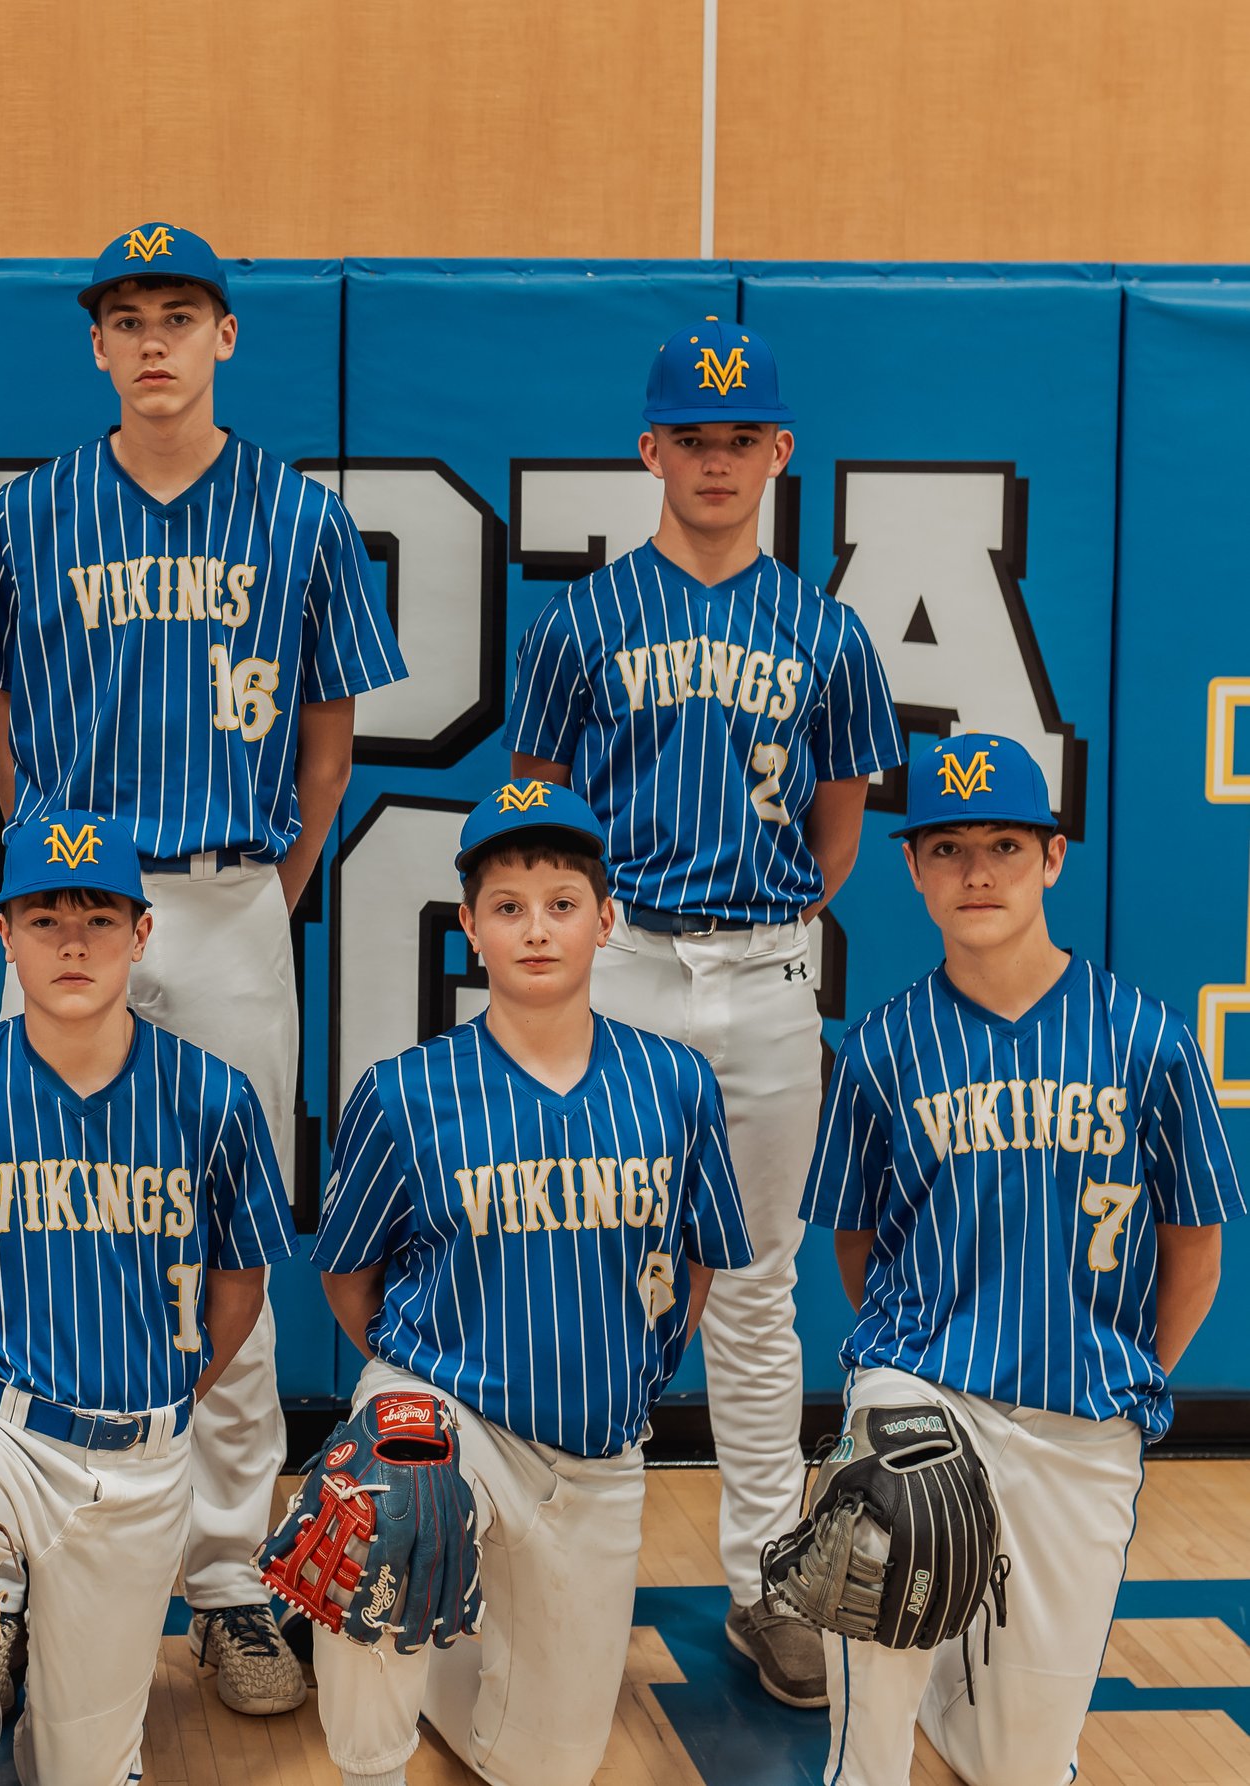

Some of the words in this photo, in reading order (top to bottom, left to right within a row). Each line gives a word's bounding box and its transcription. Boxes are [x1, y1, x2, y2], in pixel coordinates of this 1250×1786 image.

[67, 555, 257, 630] VIKINGS
[209, 644, 283, 742] 16
[614, 634, 803, 721] VIKINGS
[750, 741, 791, 827] 2
[912, 1077, 1127, 1162] VIKINGS
[454, 1156, 675, 1237] VIKINGS
[1081, 1177, 1142, 1272] 7
[167, 1263, 203, 1353] 1
[381, 1407, 431, 1424] Rawlings
[880, 1415, 947, 1435] Wilson
[361, 1563, 396, 1628] Rawlings
[907, 1569, 930, 1615] A500
